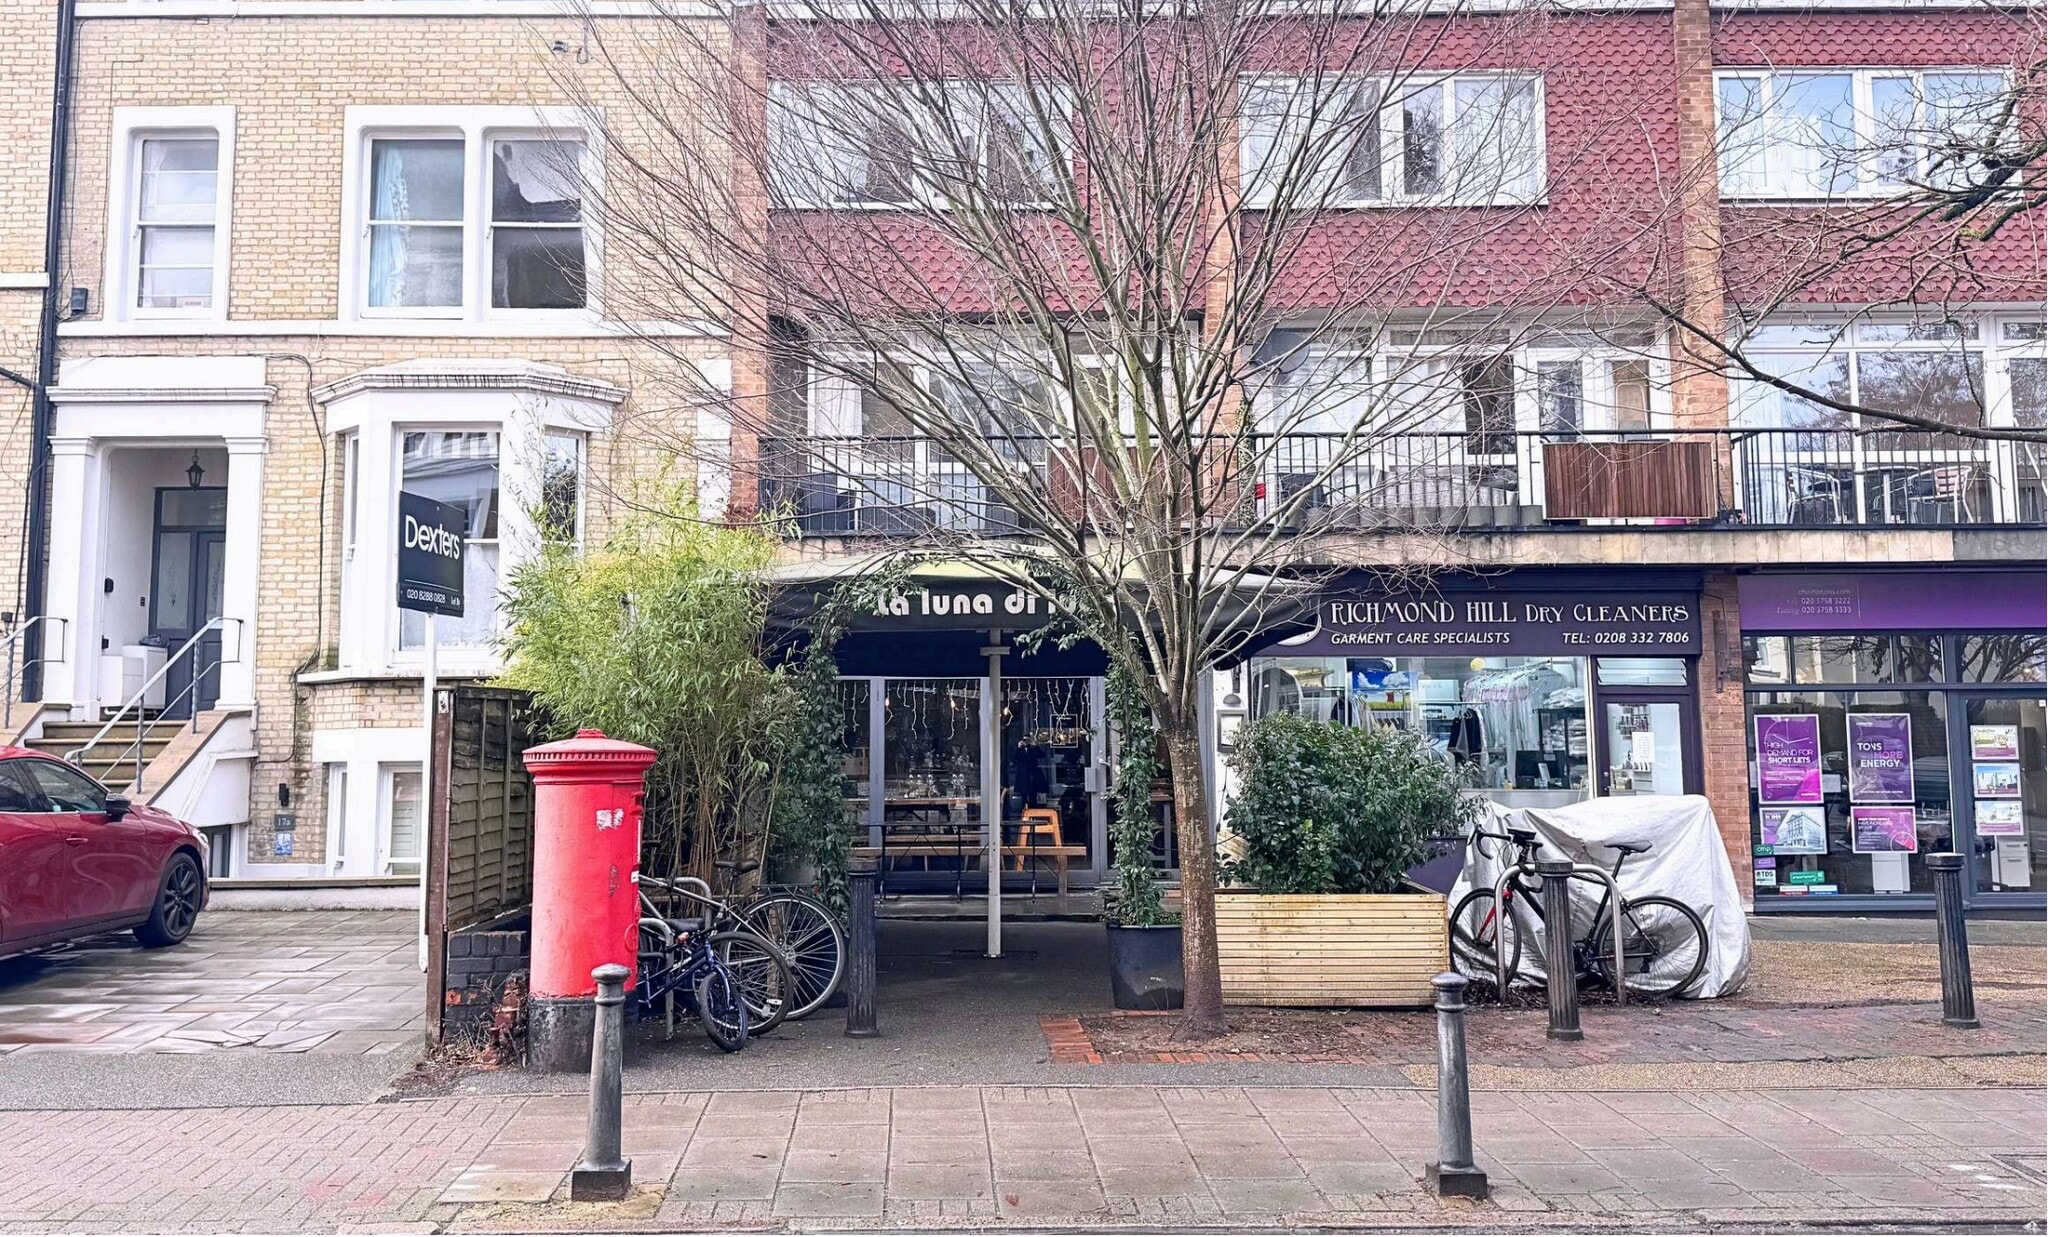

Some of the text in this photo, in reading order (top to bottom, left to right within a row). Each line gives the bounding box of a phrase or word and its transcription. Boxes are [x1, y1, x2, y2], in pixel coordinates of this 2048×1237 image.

[405, 514, 460, 560] Dexters
[407, 589, 418, 599] 020
[921, 588, 993, 616] luna
[1004, 586, 1036, 615] di
[1331, 600, 1455, 625] RICHMOND
[1467, 602, 1517, 623] HILL
[1573, 604, 1690, 623] CLEANERS
[1331, 632, 1511, 645] GARMENT CARE SPECIALISTS
[1562, 632, 1690, 644] TEL: 0208 332 7806
[1857, 742, 1882, 751] TONS
[1766, 749, 1797, 757] DEMAND
[1873, 751, 1903, 759] MORE
[1860, 759, 1900, 768] ENERGY
[278, 817, 291, 826] 17a
